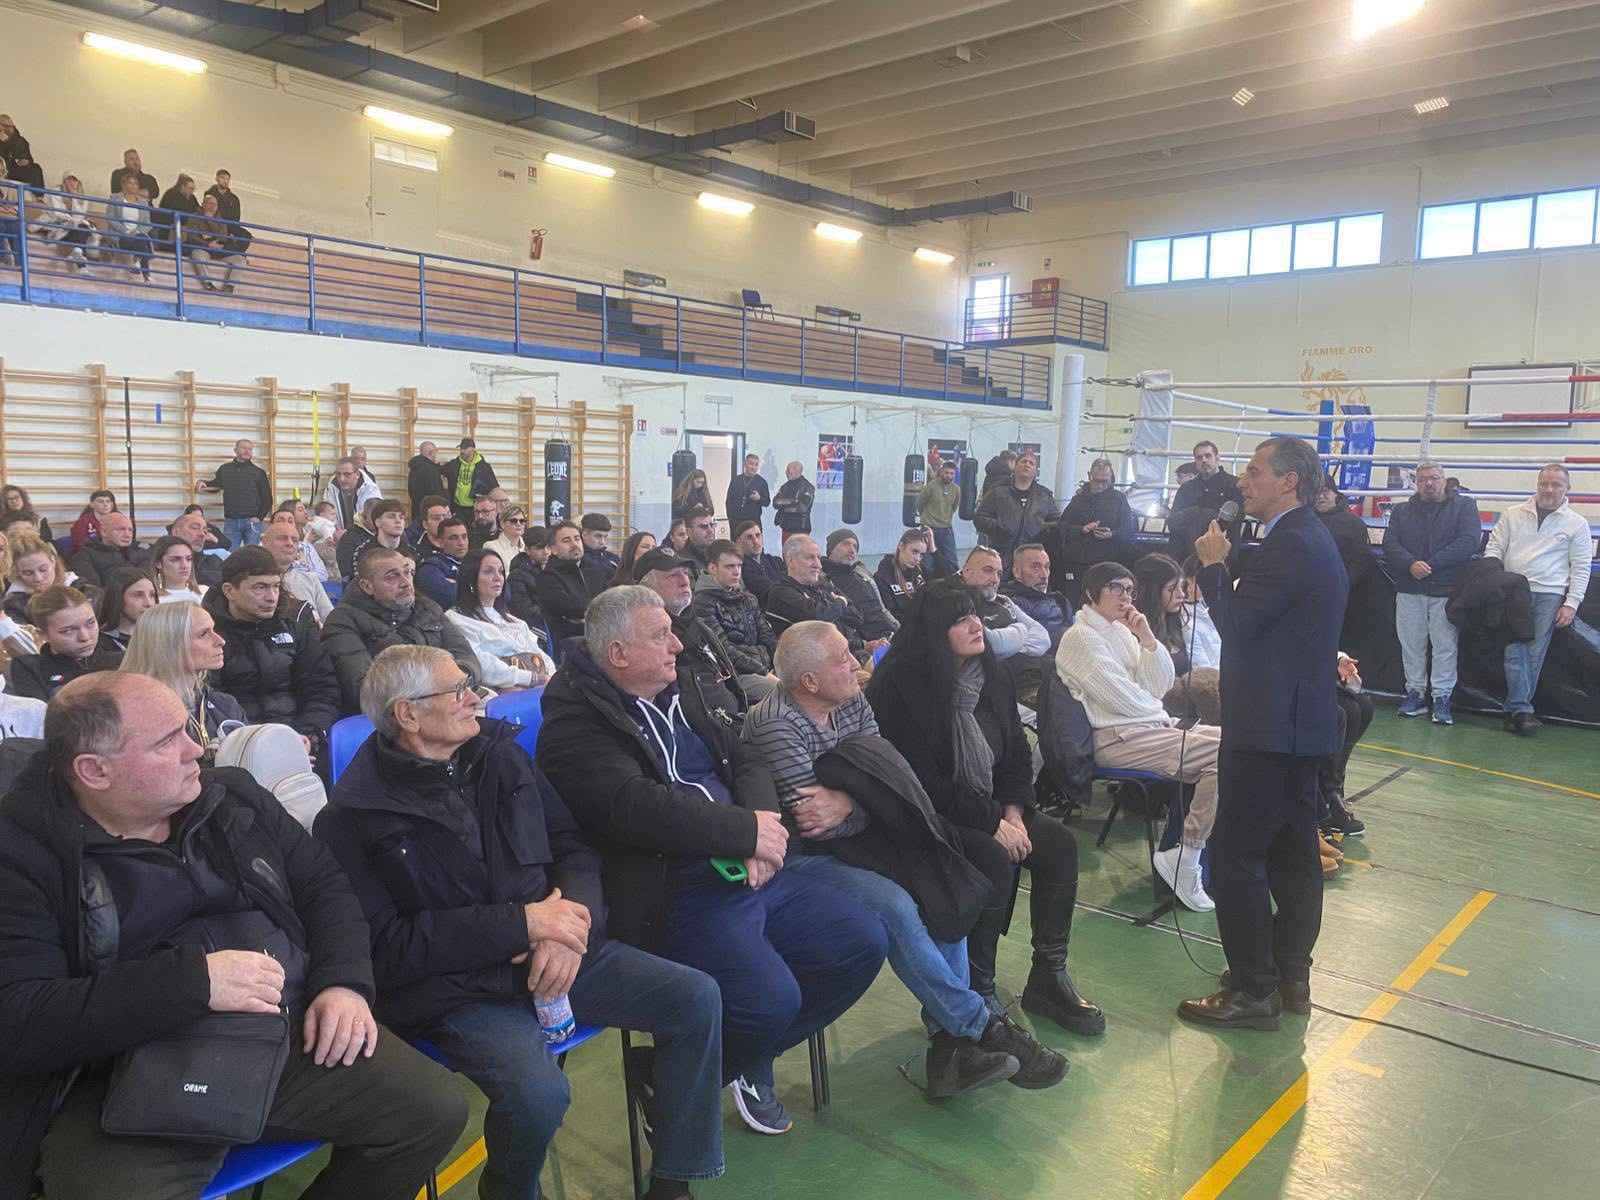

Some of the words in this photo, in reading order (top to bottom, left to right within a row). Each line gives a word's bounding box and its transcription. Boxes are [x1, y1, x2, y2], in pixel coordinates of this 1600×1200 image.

[1302, 346, 1345, 357] FIAMME
[1349, 345, 1373, 354] ORO
[547, 461, 568, 477] LEONE
